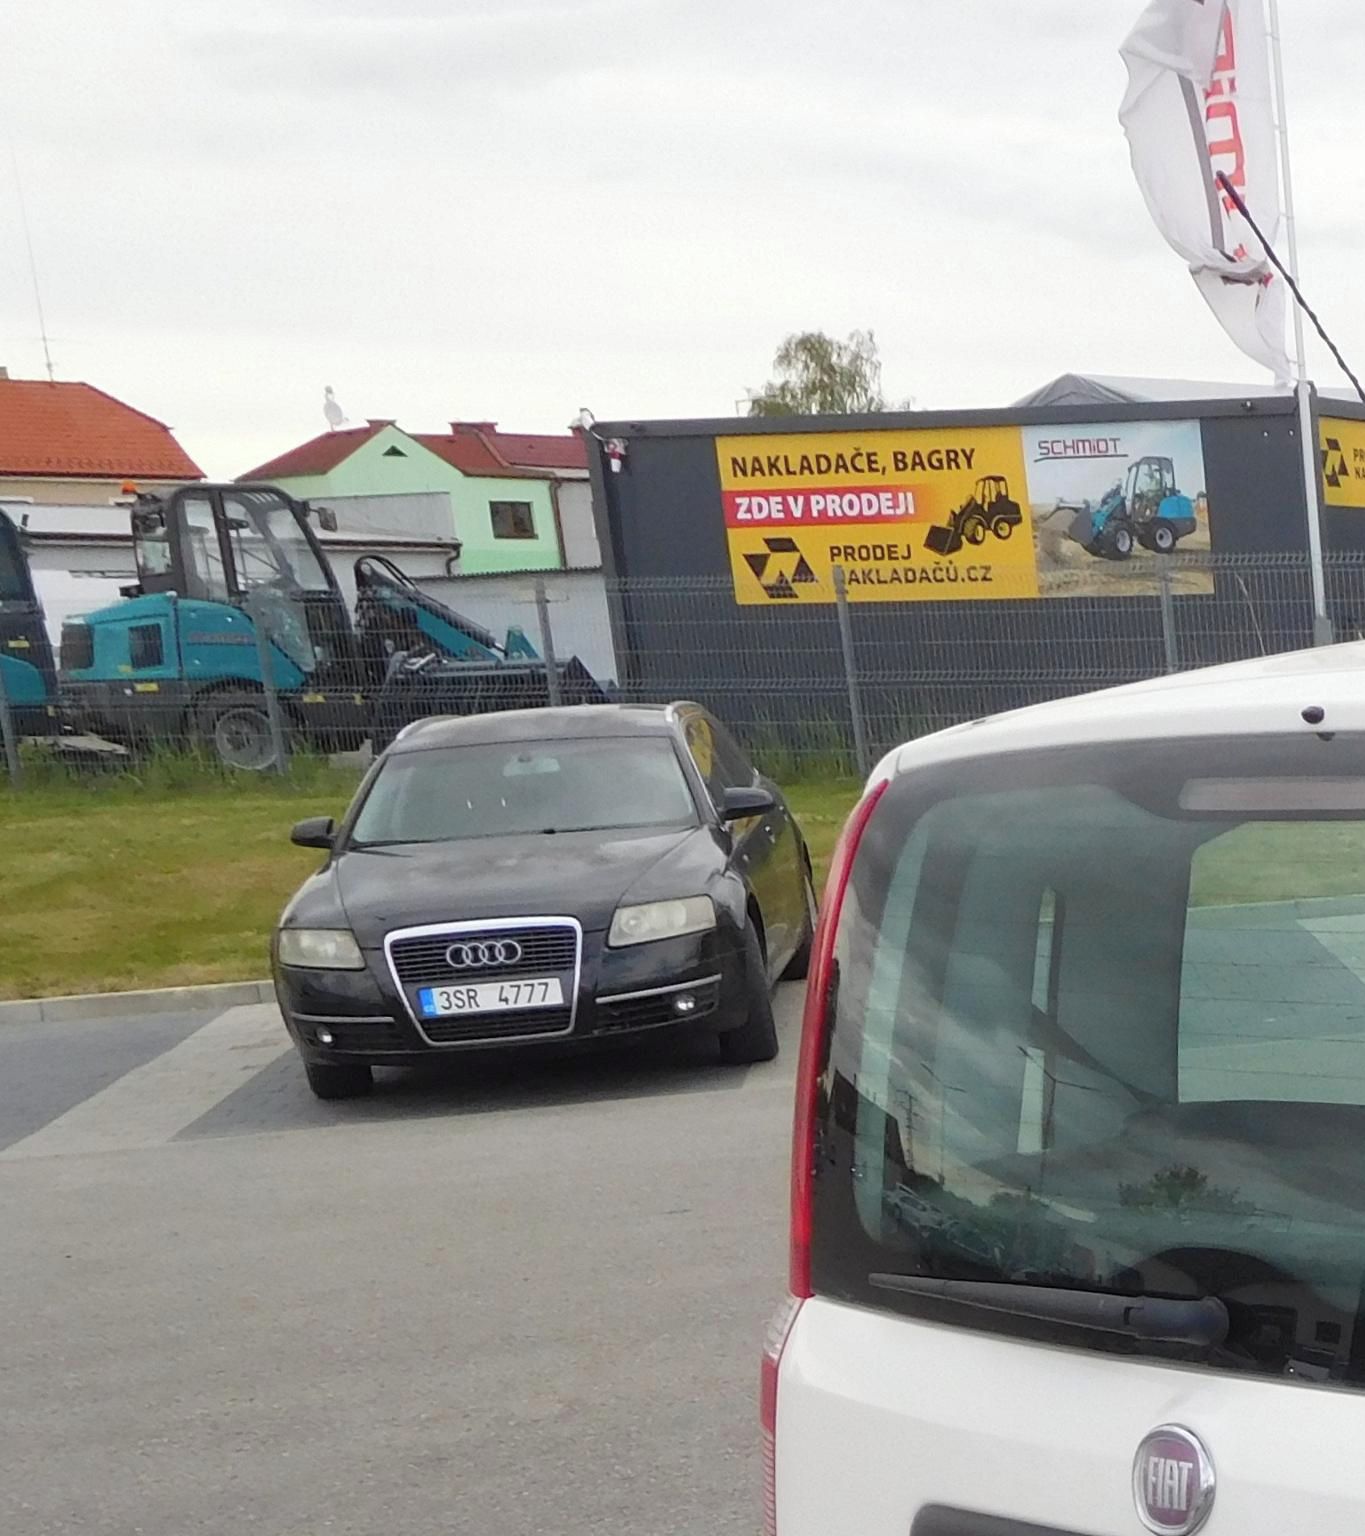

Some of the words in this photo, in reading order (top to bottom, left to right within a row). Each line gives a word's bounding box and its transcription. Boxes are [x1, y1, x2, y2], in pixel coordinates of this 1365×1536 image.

[731, 447, 887, 478] NAKLADAČE,
[892, 448, 976, 473] BAGRY
[735, 495, 785, 520] ZDE
[786, 495, 805, 518] V
[811, 491, 915, 517] PRODEJI
[829, 543, 912, 563] PRODEJ
[836, 560, 993, 586] AKLADAČŮ.CZ
[439, 988, 480, 1011] 3SR
[498, 981, 549, 1006] 4777
[1147, 1455, 1193, 1511] FIAT
